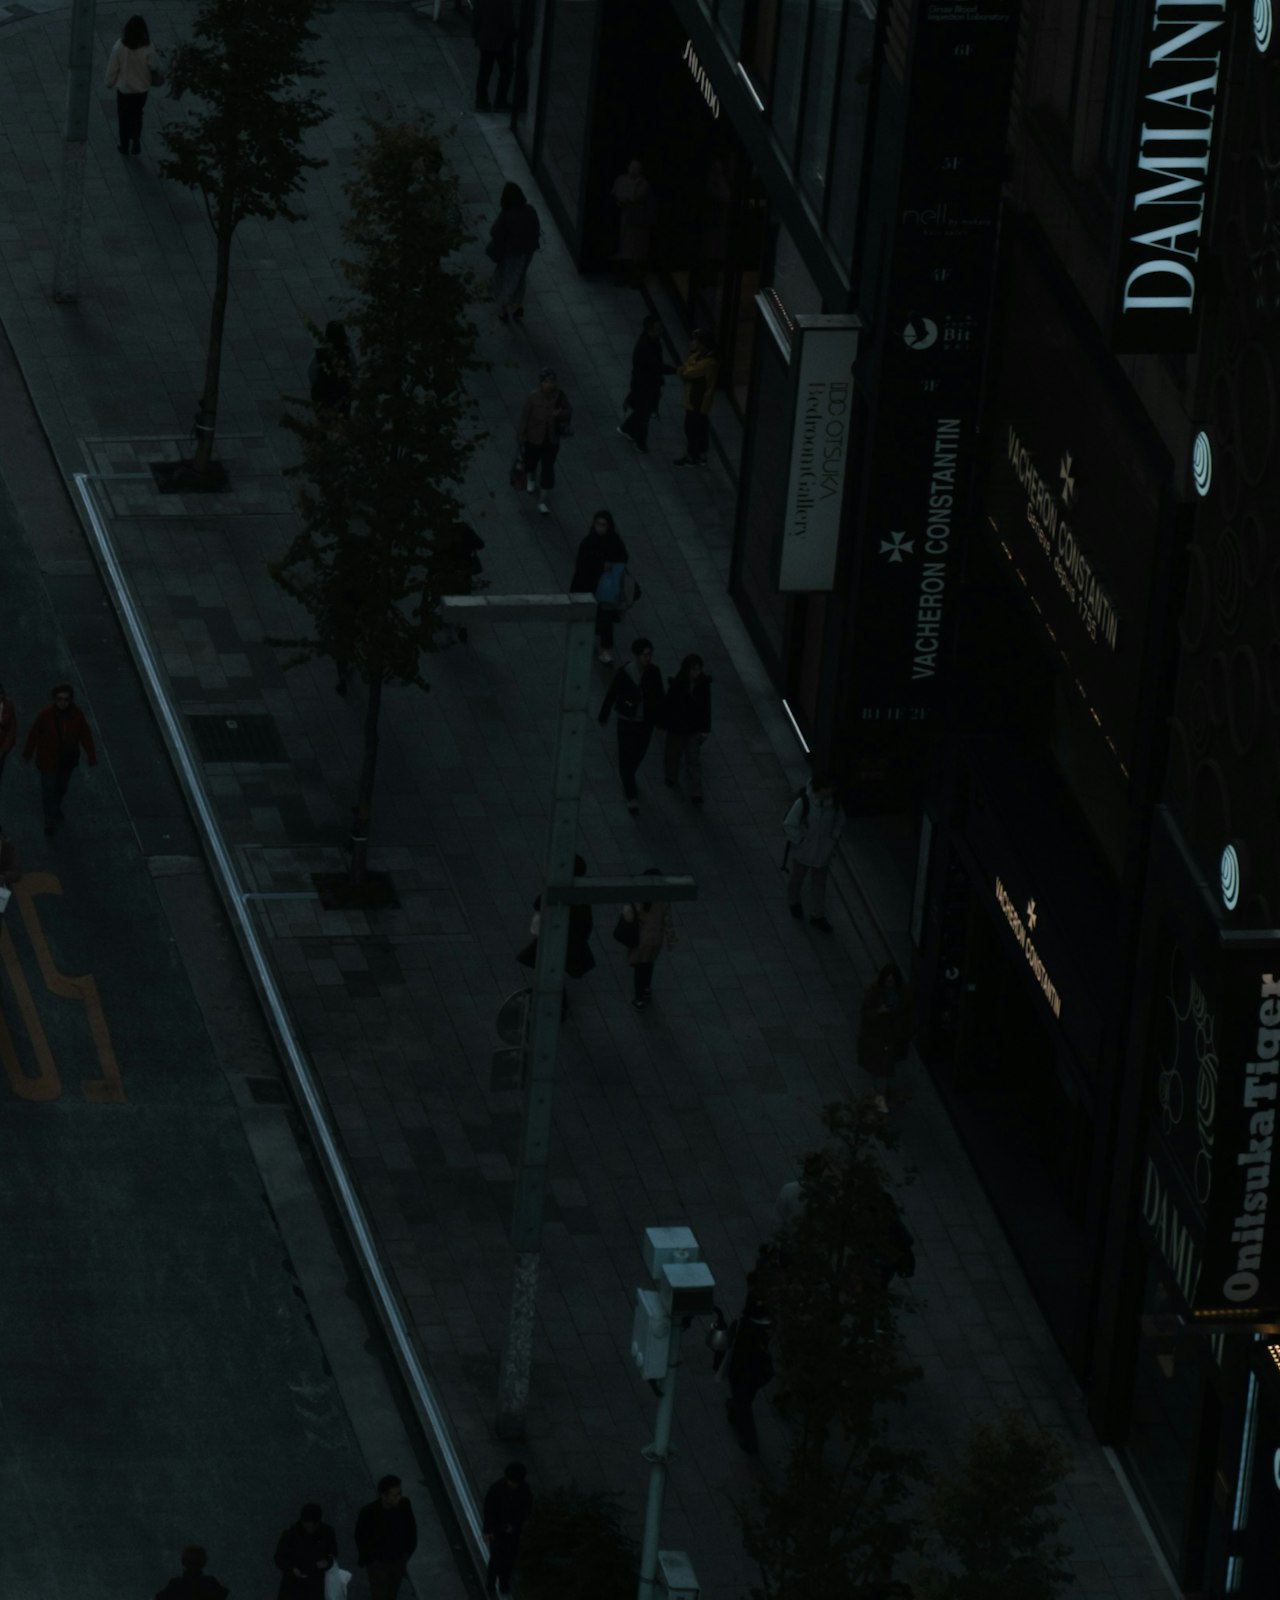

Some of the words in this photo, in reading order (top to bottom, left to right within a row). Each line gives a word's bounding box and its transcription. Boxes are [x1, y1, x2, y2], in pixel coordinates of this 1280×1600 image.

[901, 203, 948, 225] nell
[820, 419, 845, 501] OTSUKA
[924, 417, 961, 554] CONSTANTIN
[1007, 424, 1058, 540] VACHERON
[1057, 519, 1119, 653] CONSTANTIN
[911, 560, 946, 681] VACHERON
